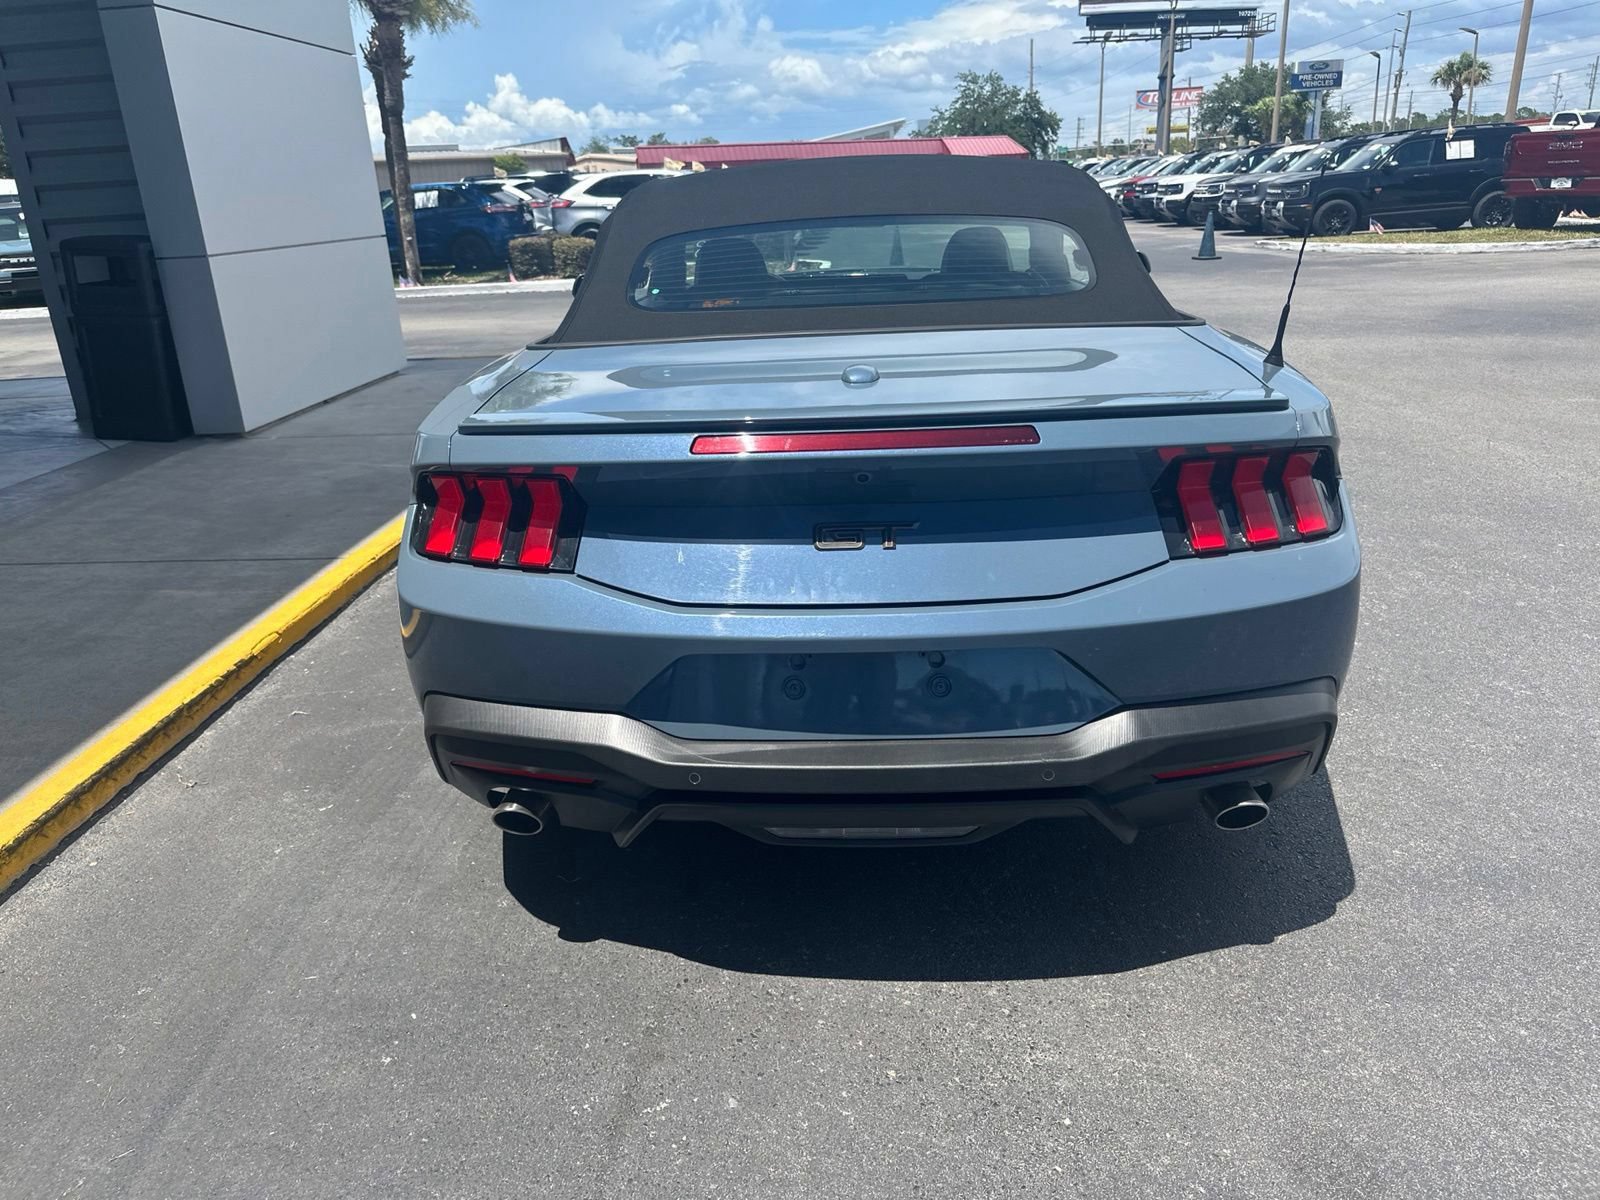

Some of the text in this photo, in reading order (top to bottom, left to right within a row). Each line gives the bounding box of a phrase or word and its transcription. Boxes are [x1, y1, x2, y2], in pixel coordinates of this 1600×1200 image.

[1298, 73, 1338, 81] PRE-OWNED
[1301, 79, 1334, 88] VEHICLES
[814, 521, 921, 551] GT
